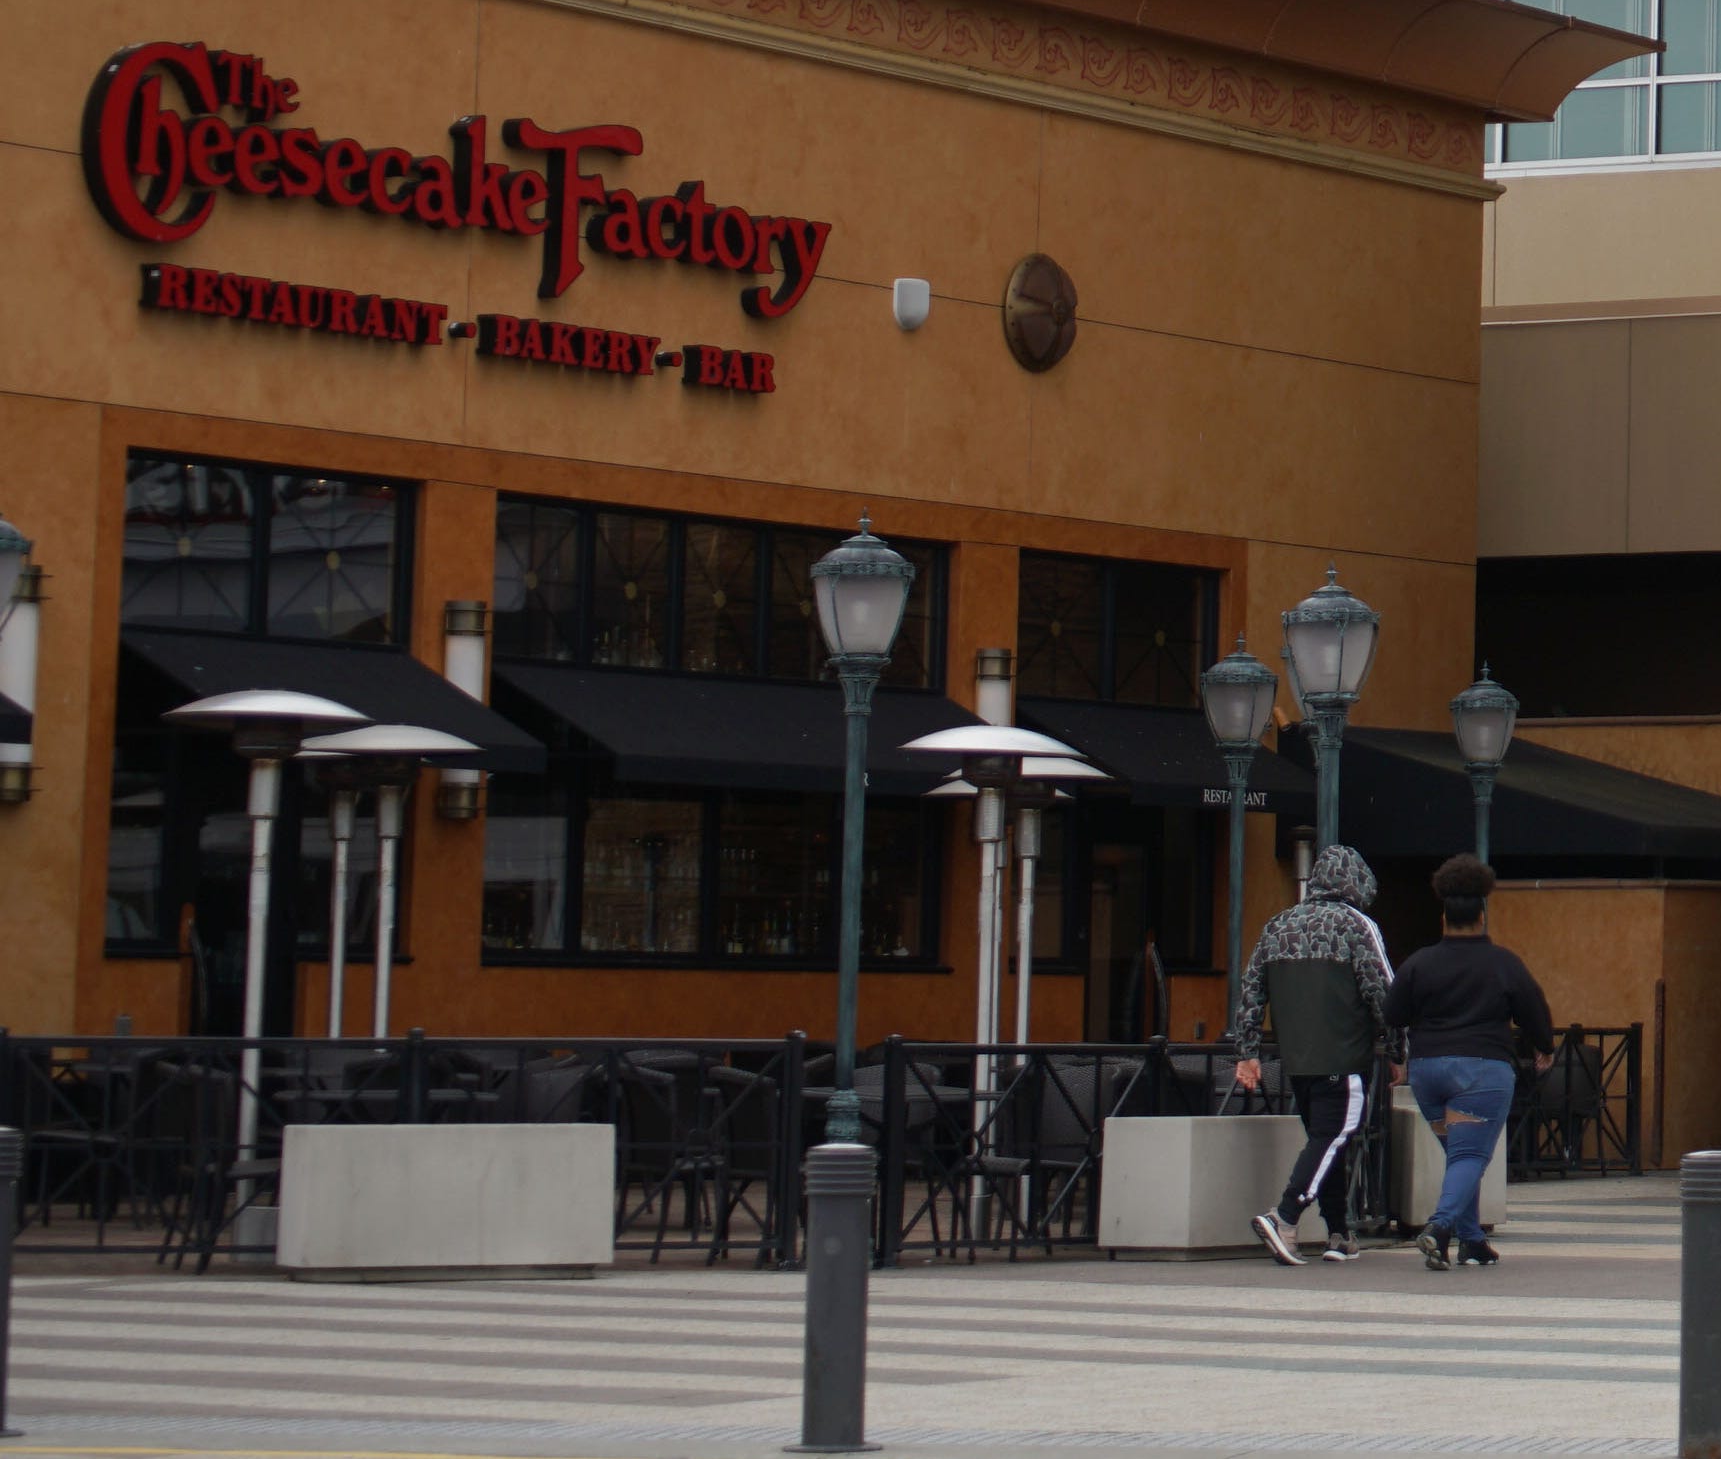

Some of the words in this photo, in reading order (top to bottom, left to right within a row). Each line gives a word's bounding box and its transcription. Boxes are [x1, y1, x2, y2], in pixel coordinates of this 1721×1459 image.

[214, 52, 301, 116] The
[86, 42, 549, 244] Cheesecake
[504, 119, 831, 319] Factory
[148, 264, 448, 345] RESTAURANT
[484, 316, 661, 378] BAKERY
[690, 347, 776, 394] BAR
[1203, 788, 1267, 806] RESTARANT
